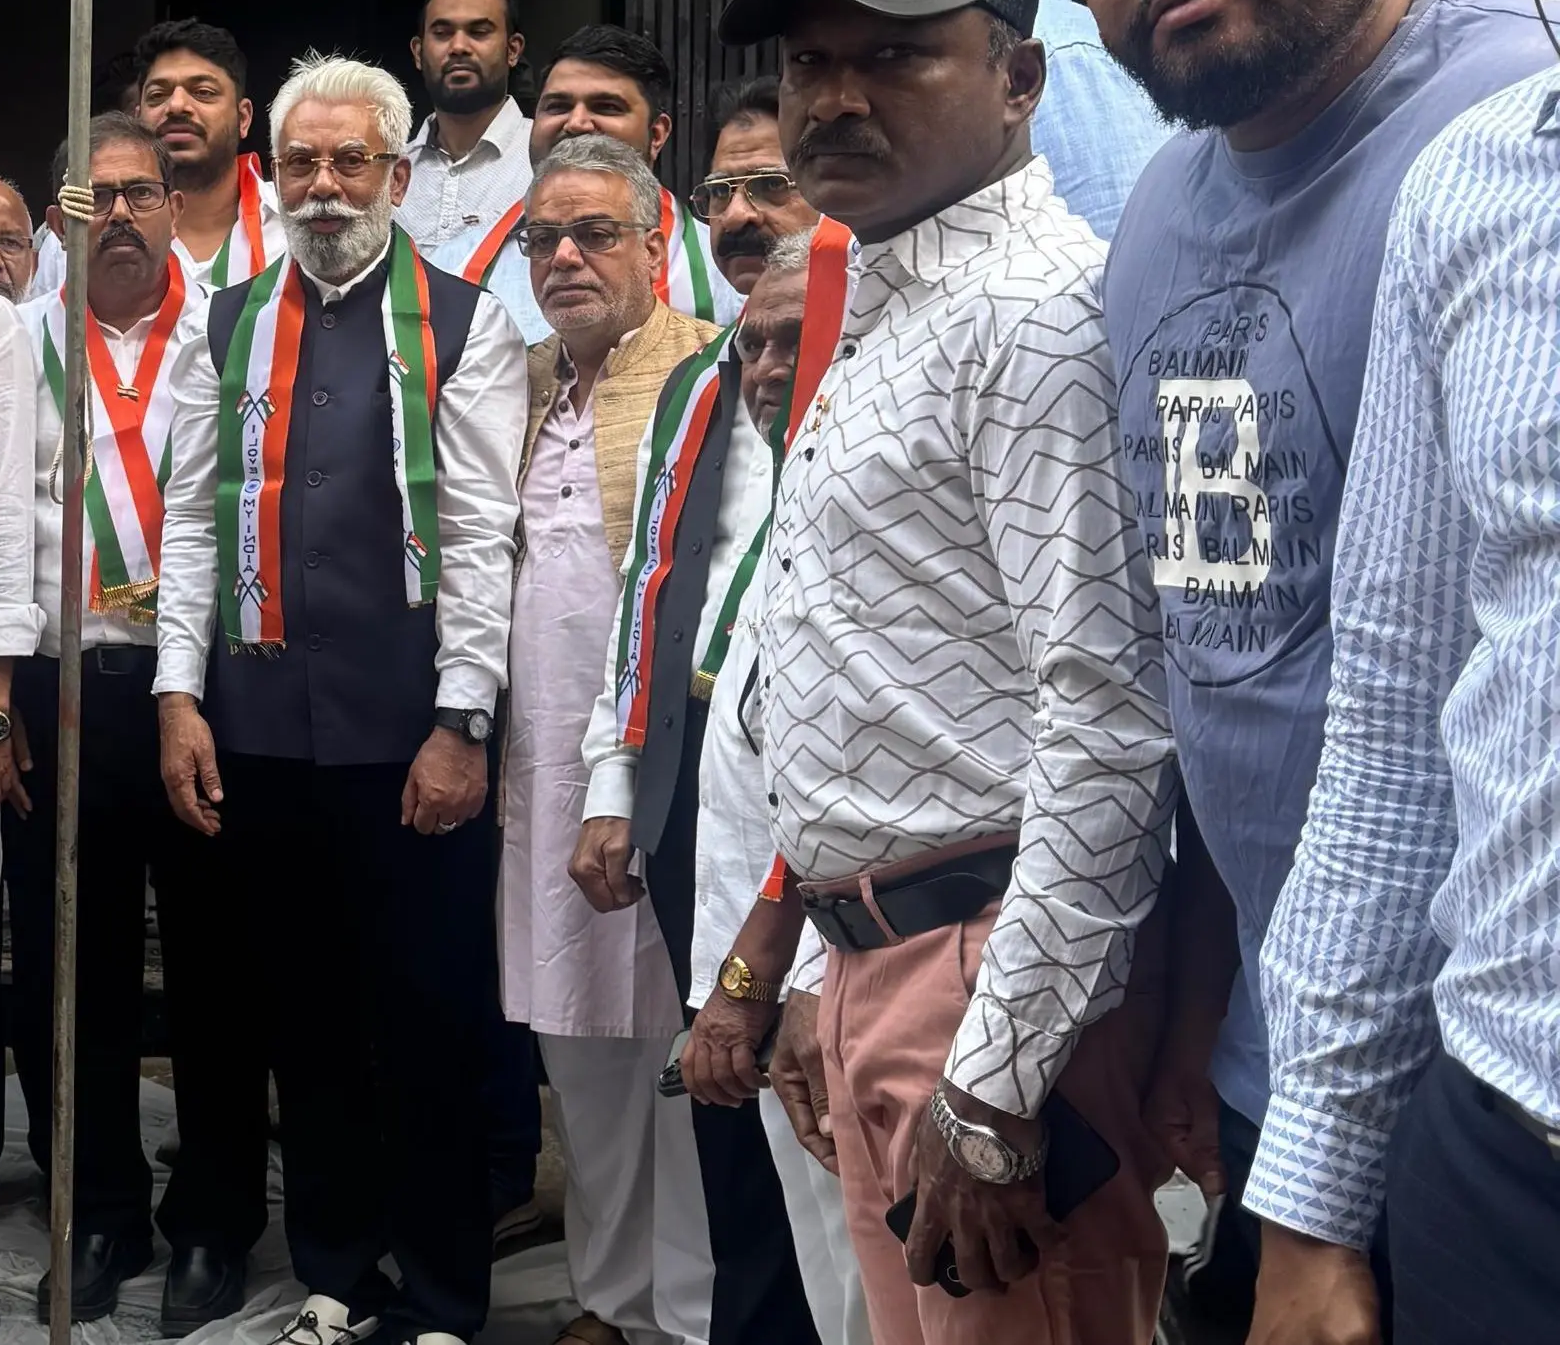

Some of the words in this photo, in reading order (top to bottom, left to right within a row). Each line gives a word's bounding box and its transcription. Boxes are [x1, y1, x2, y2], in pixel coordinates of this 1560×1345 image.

[1201, 312, 1269, 345] PARIS
[1148, 348, 1250, 377] BALMAIN
[1155, 395, 1224, 423] PARIS
[1234, 389, 1296, 423] PARIS
[1124, 434, 1182, 463] PARIS
[1201, 451, 1308, 484] BALMAIN
[1135, 491, 1216, 521] ALMAIN
[1231, 494, 1314, 524] PARIS
[1146, 534, 1185, 561] RIS
[1204, 536, 1321, 569] BALMAIN
[1183, 577, 1303, 611] BALMAIN
